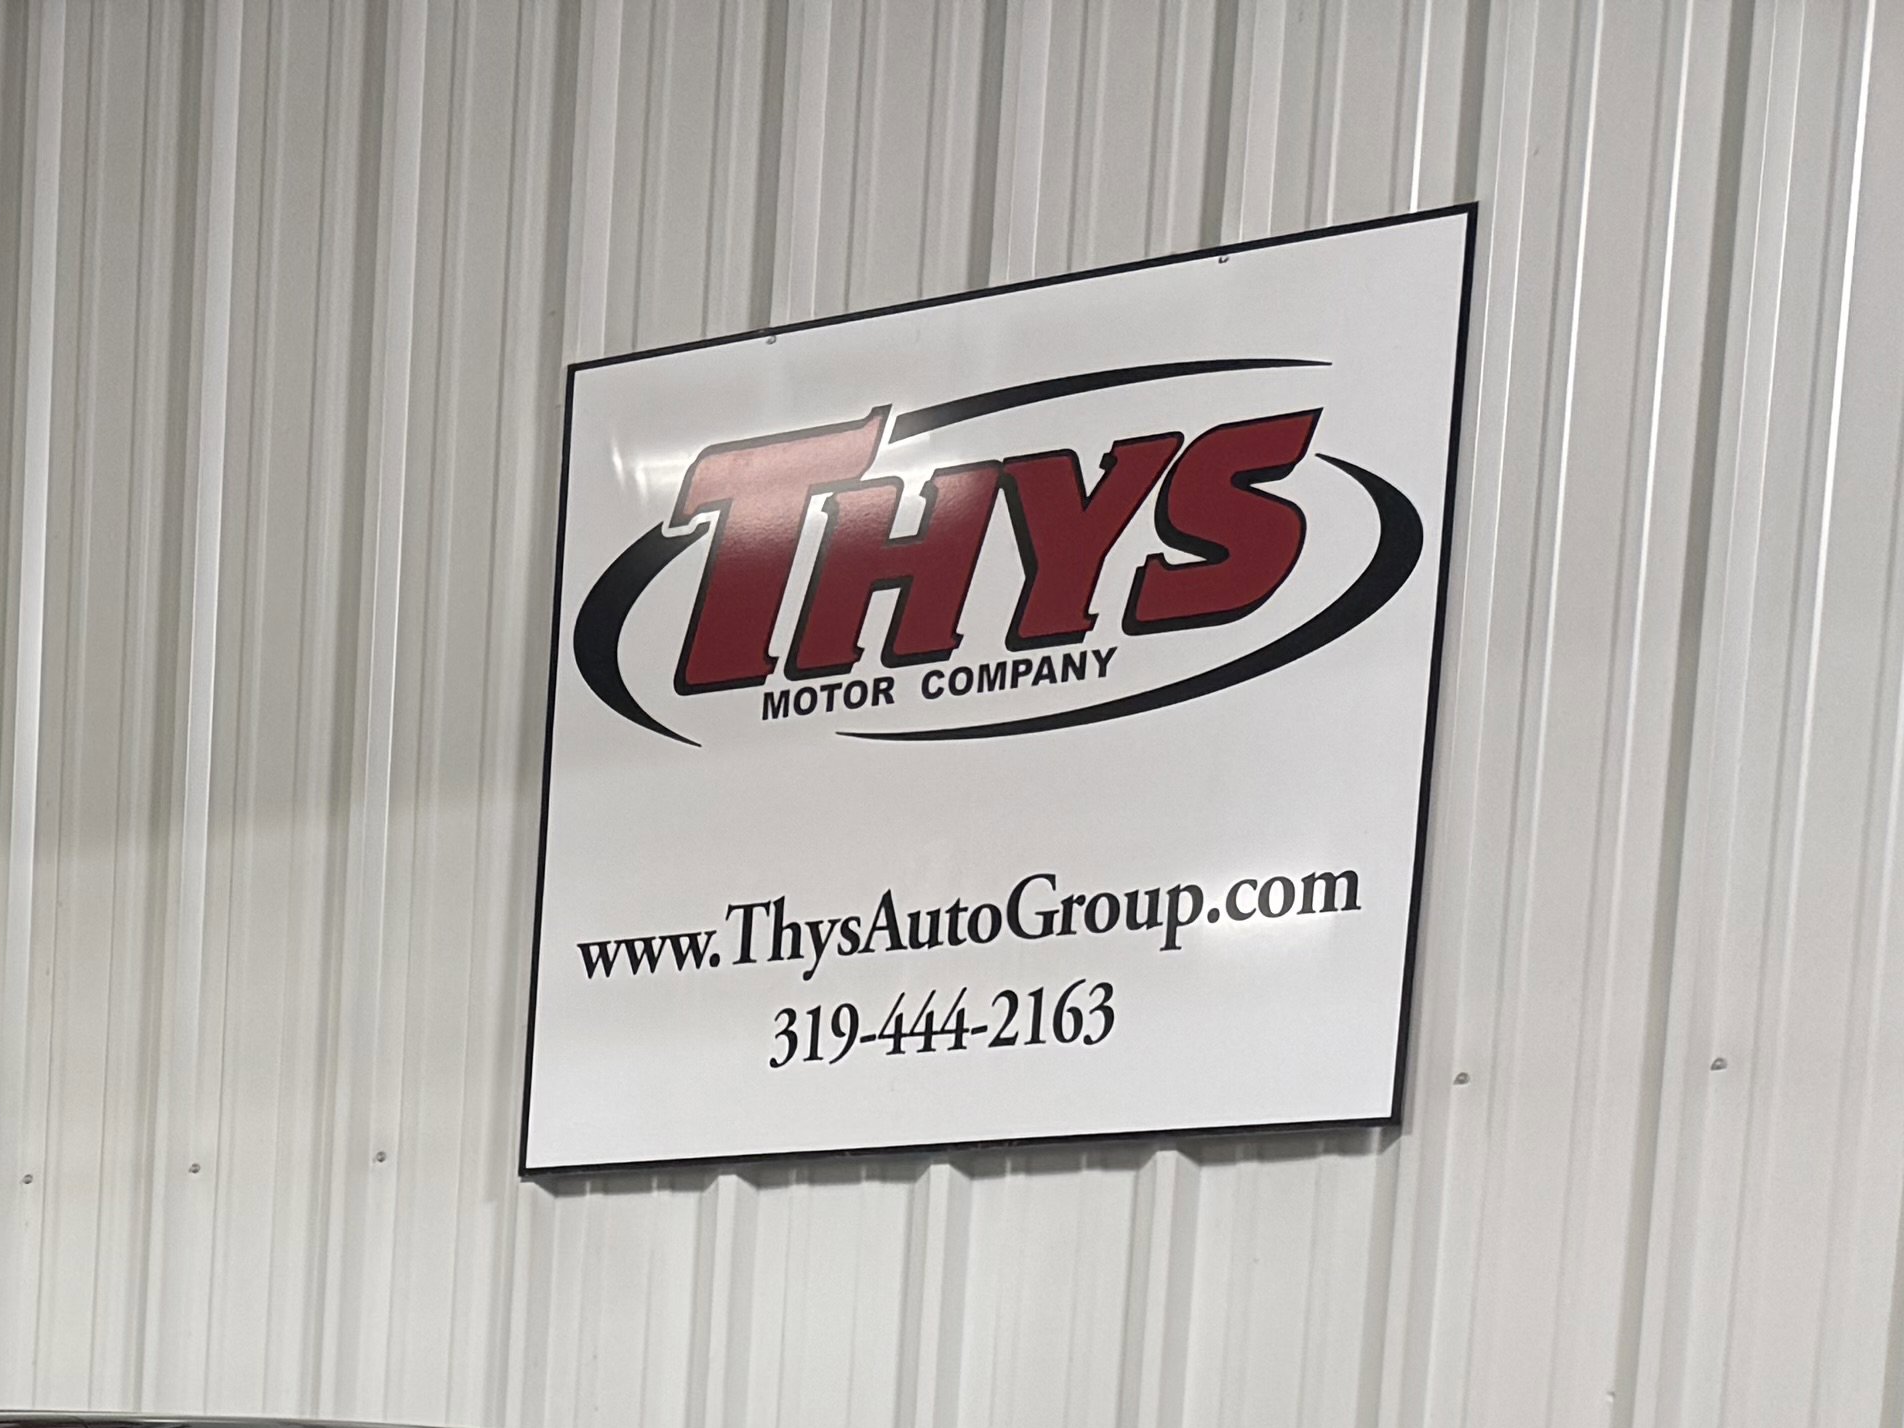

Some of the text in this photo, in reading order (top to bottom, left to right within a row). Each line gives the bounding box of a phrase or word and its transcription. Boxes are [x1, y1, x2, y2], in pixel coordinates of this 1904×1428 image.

[669, 403, 1324, 696] THYS
[762, 646, 1118, 721] MOTOR COMPANY
[578, 862, 1362, 981] www.ThysAutoGroup.com
[768, 978, 1117, 1069] 319-444-2163
